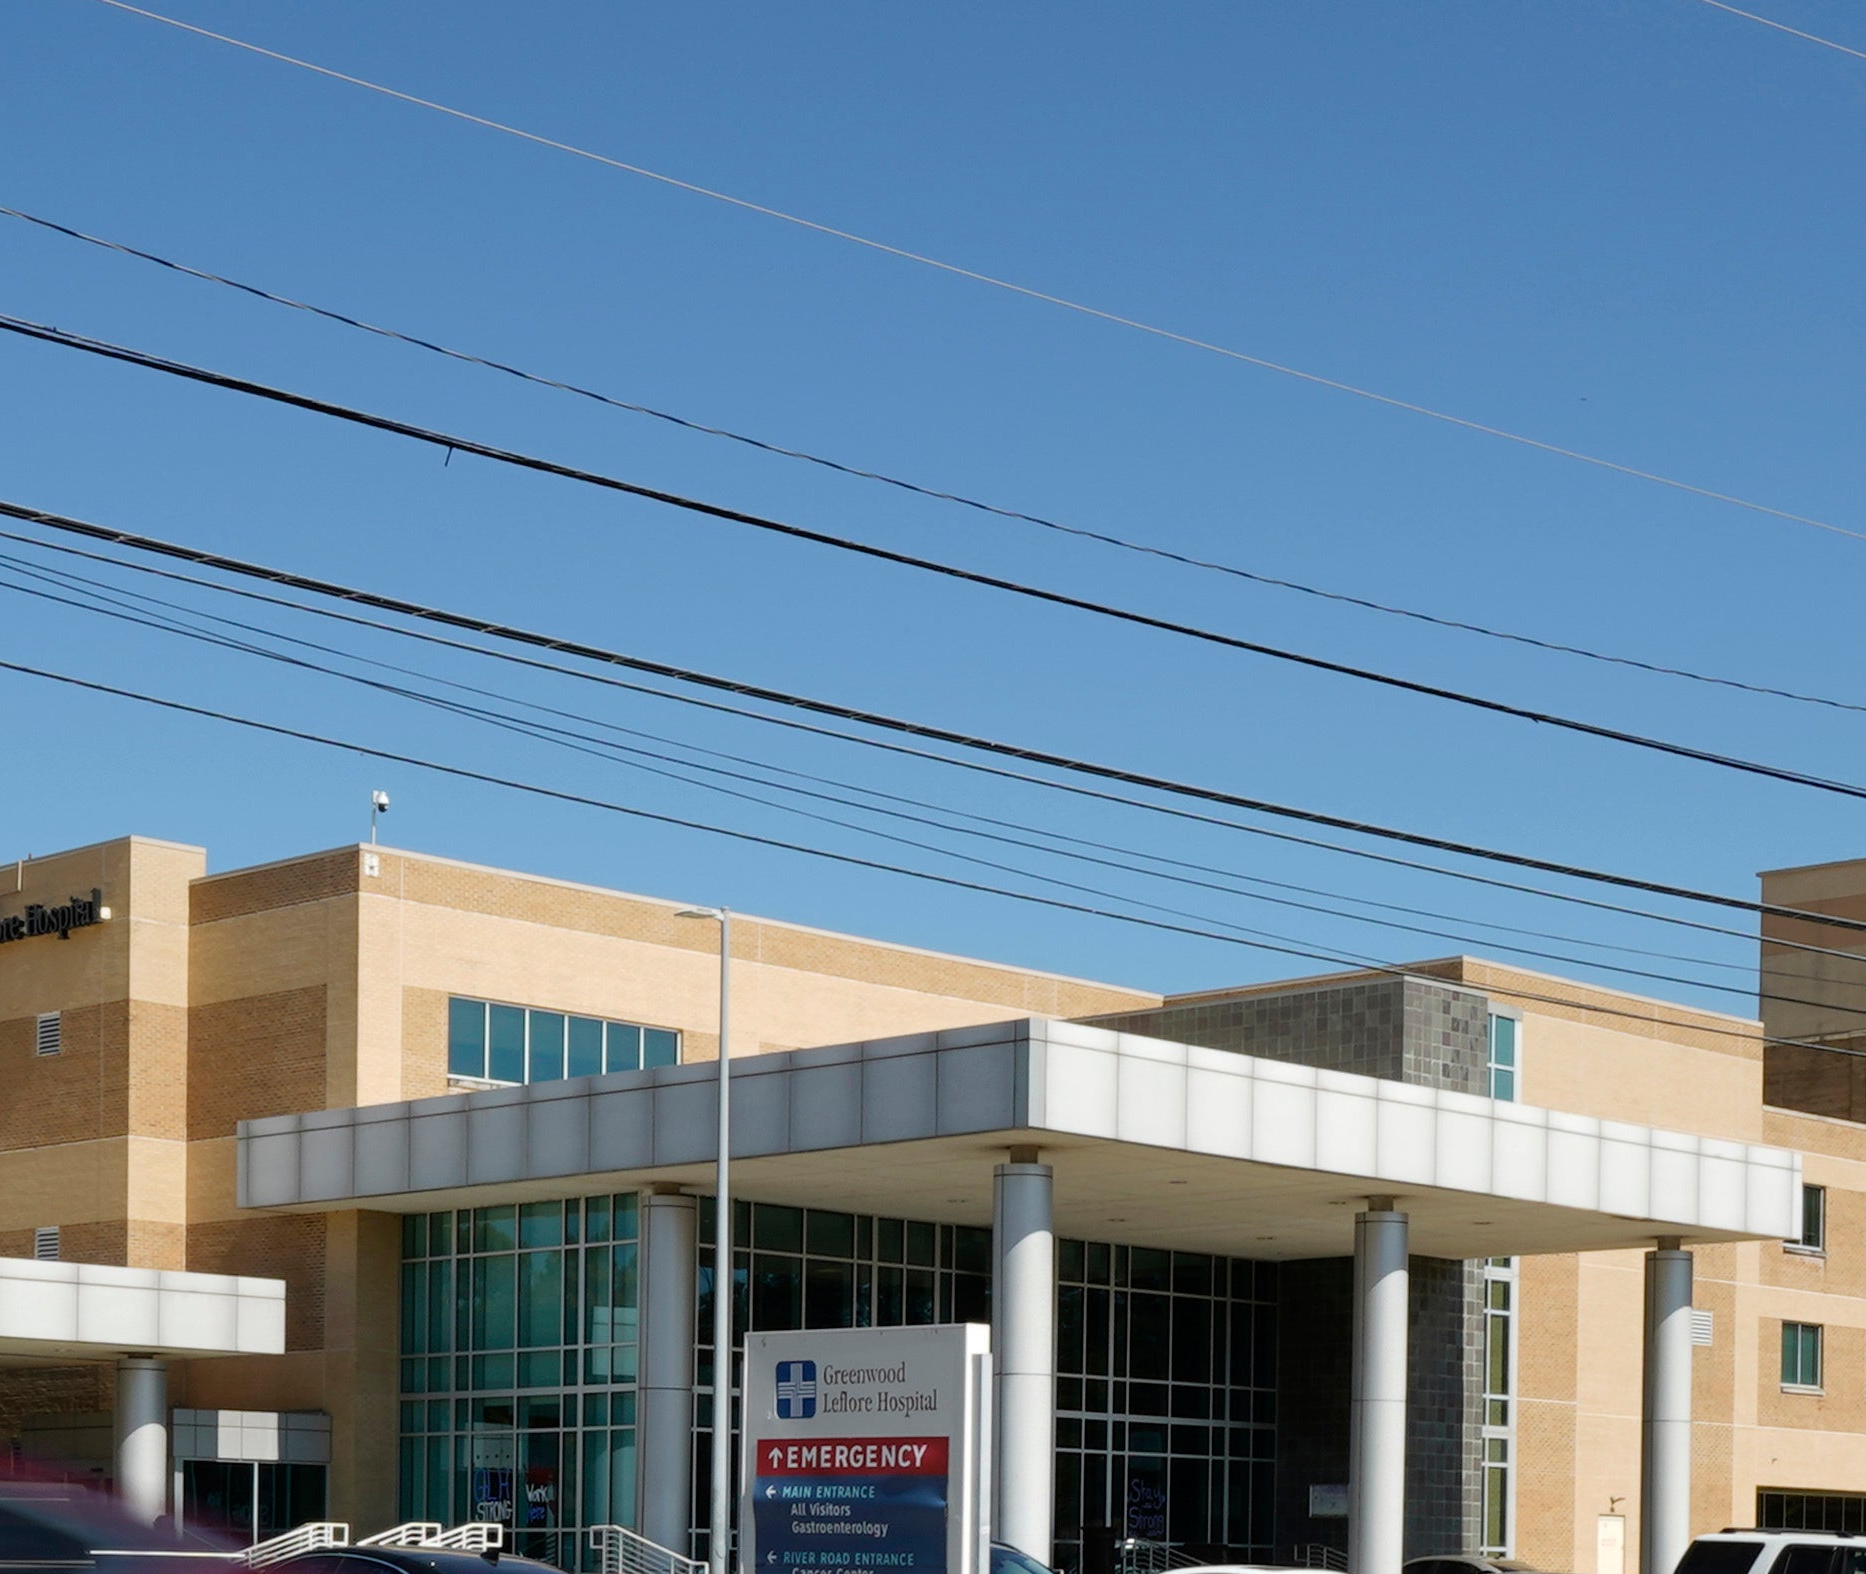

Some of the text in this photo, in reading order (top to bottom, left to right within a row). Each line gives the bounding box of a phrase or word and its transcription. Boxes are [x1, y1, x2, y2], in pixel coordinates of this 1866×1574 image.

[25, 888, 101, 939] Hospital
[823, 1362, 905, 1385] Greenwood
[823, 1389, 937, 1417] Leflore Hospital
[787, 1444, 927, 1468] EMERGENCY
[782, 1486, 875, 1498] MAIN ENTRANCE
[791, 1504, 850, 1517] All Visitors
[792, 1521, 888, 1537] Gastroenterology
[783, 1552, 914, 1566] RIVER ROAD ENTRANCE
